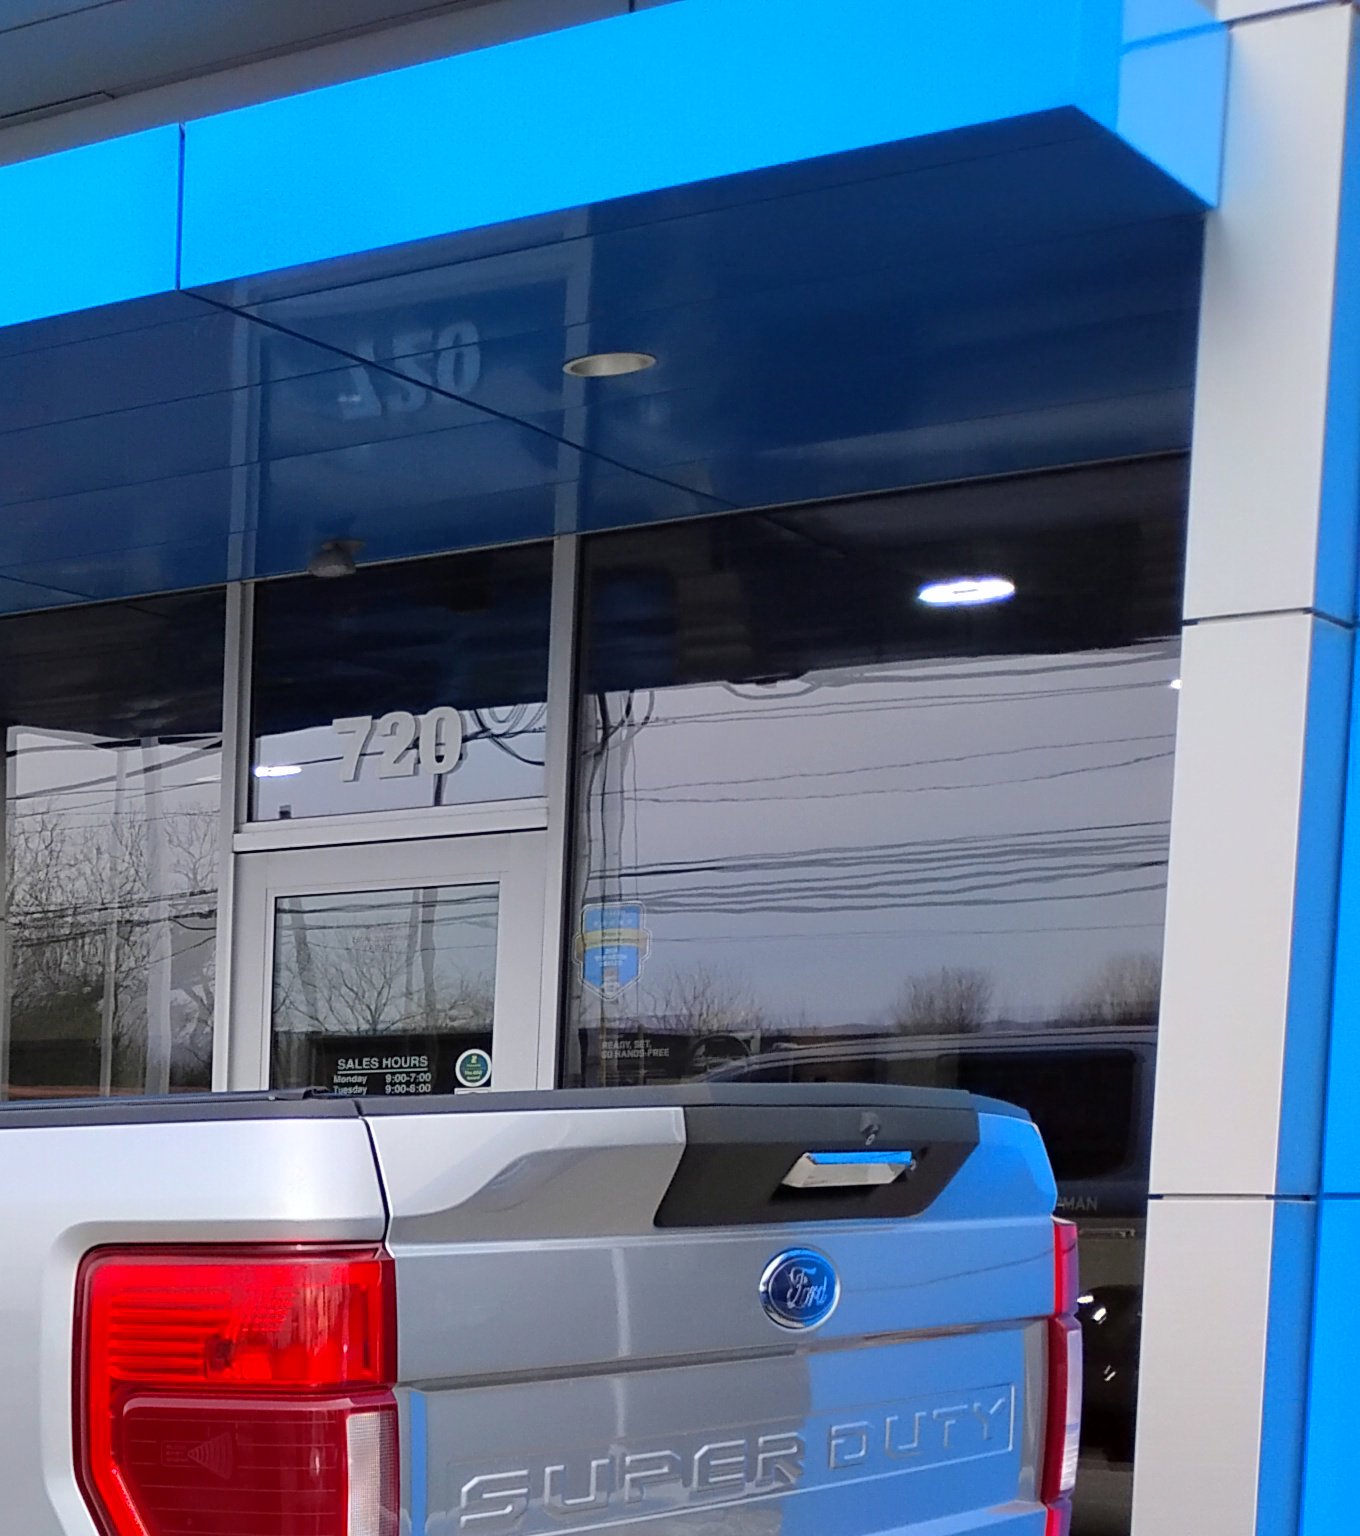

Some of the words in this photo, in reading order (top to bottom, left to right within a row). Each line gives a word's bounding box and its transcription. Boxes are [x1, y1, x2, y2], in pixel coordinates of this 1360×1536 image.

[332, 706, 466, 782] 720
[337, 1058, 379, 1070] SALES
[382, 1055, 428, 1069] HOURS
[333, 1074, 368, 1085] Monday
[385, 1072, 431, 1083] 9:00-7:00
[333, 1085, 368, 1096] Tuesday
[786, 1267, 828, 1309] Ford
[459, 1430, 806, 1532] SUPER
[827, 1395, 1008, 1470] DUTY
